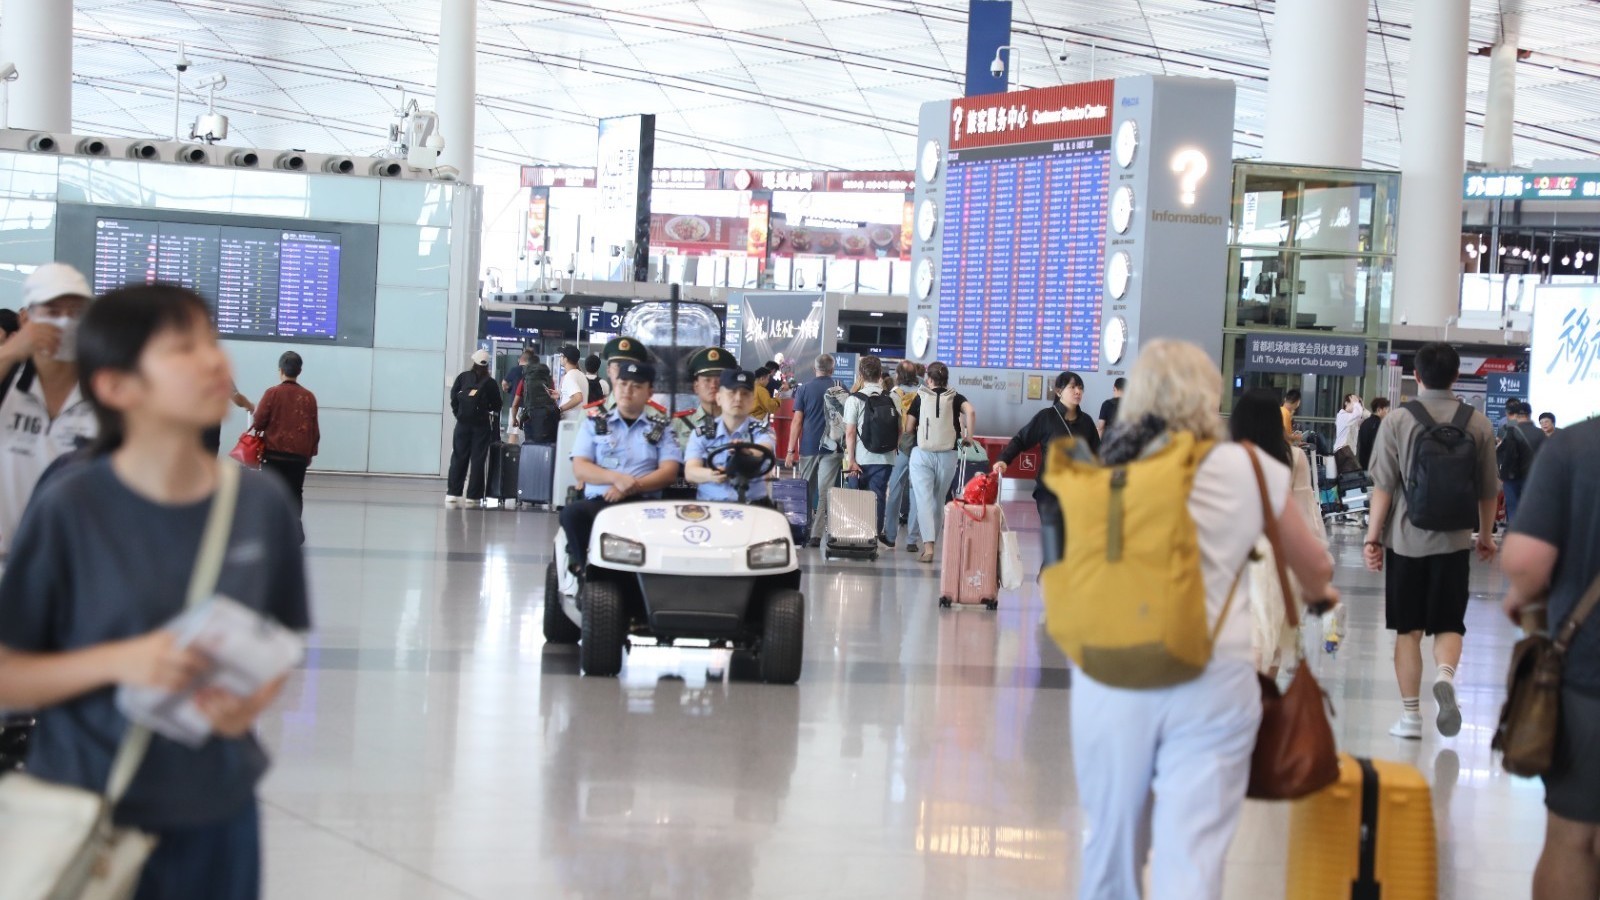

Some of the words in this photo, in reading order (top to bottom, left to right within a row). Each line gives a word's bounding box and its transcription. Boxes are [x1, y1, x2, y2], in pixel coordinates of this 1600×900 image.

[1152, 209, 1222, 225] Information
[589, 313, 600, 327] F
[610, 314, 624, 328] 3
[1252, 340, 1359, 357] 首都机场常旅客会员休息室直梯
[1252, 355, 1264, 363] Lift
[1265, 355, 1274, 363] To
[1275, 356, 1300, 366] Airport
[1302, 358, 1318, 366] Club
[1320, 358, 1348, 369] Lounge
[687, 530, 705, 540] 17
